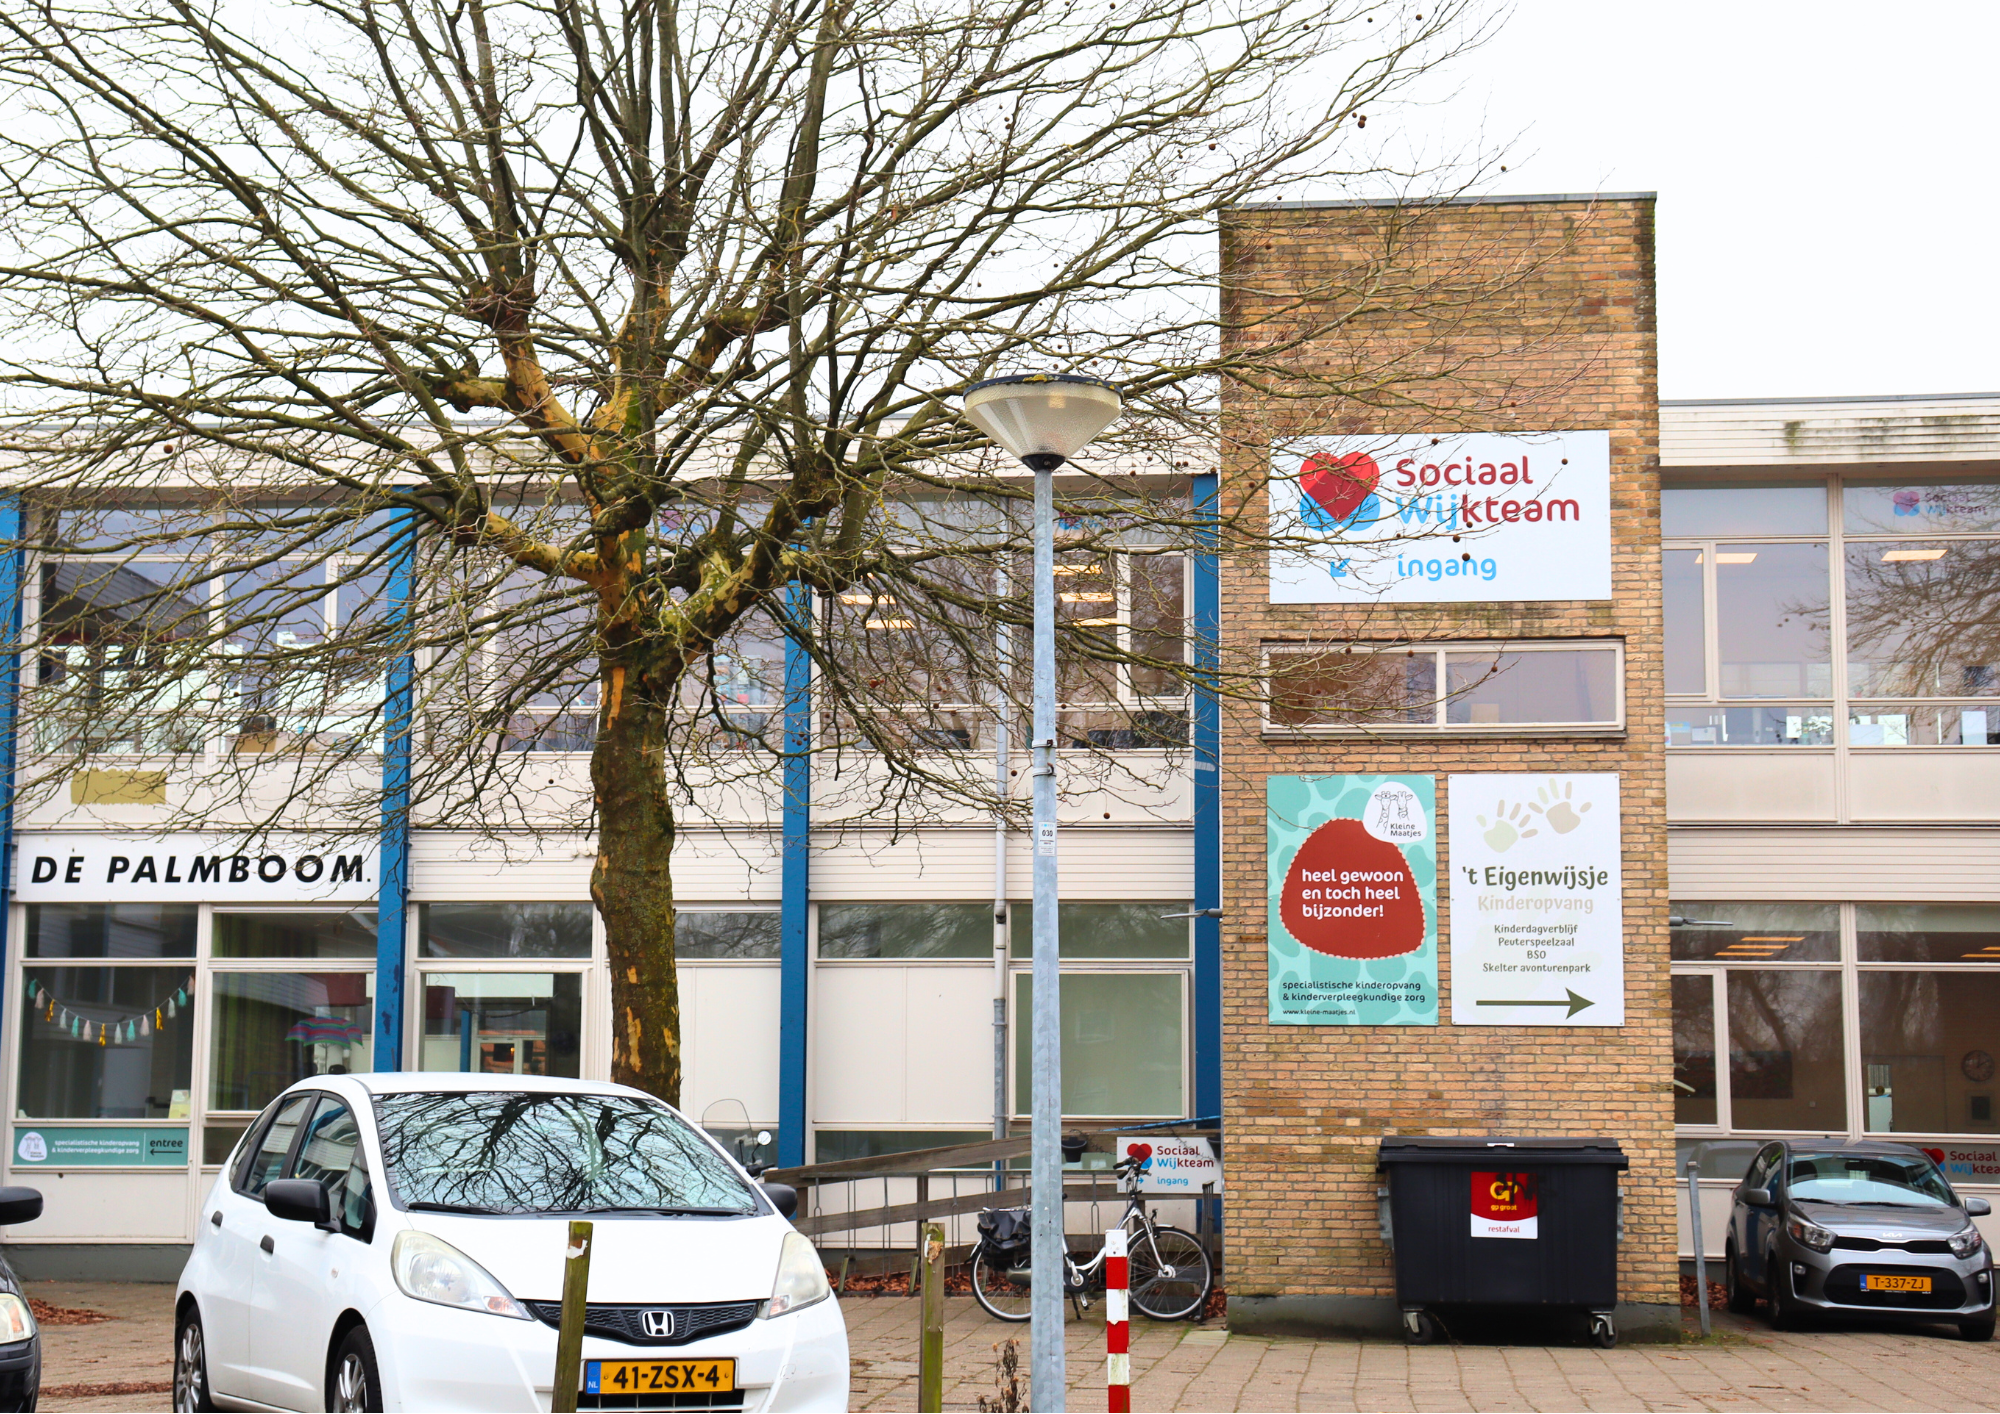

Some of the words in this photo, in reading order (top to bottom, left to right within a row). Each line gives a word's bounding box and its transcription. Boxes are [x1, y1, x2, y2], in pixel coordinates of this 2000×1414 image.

[1395, 455, 1534, 487] Sociaal
[1395, 493, 1580, 531] Wijkteam
[1397, 553, 1497, 582] ingang
[1390, 822, 1416, 830] Kleine
[1390, 830, 1422, 838] Maatjes
[31, 856, 84, 884] DE
[106, 854, 371, 884] PALMBOOM.
[1301, 868, 1337, 882] heel
[1340, 871, 1404, 885] gewoon
[1462, 866, 1478, 885] 't
[1484, 865, 1609, 891] Eigenwijsje
[1301, 888, 1321, 900] en
[1325, 886, 1361, 900] toch
[1365, 886, 1401, 900] heel
[1477, 894, 1594, 915] Kinderopvang
[1302, 903, 1384, 920] bijzonder!
[1494, 924, 1579, 936] Kinderdagverblijf
[1498, 937, 1575, 948] Peuterspeelzaal
[1527, 950, 1547, 960] BSO
[1482, 962, 1518, 973] Skelter
[1519, 963, 1591, 974] avonturenpark
[1282, 980, 1353, 991] specialistische
[1355, 981, 1421, 991] kinderopvang
[1282, 992, 1290, 1001] &
[1291, 992, 1402, 1003] kinderverpleegkundige
[1404, 994, 1426, 1003] zorg
[1282, 1008, 1356, 1016] www.kleine-maatjes.nl
[149, 1139, 184, 1148] entree
[1156, 1145, 1200, 1156] Sociaal
[1949, 1150, 1998, 1162] Sociaal
[1156, 1157, 1215, 1170] Wijkteam
[1949, 1162, 2000, 1176] Wijktea
[1156, 1176, 1189, 1187] ingang
[1490, 1204, 1500, 1212] gp
[1488, 1225, 1520, 1233] restafval
[1873, 1277, 1924, 1290] T-337-ZJ
[612, 1364, 720, 1390] 41-ZSX-4
[588, 1380, 599, 1389] NL
